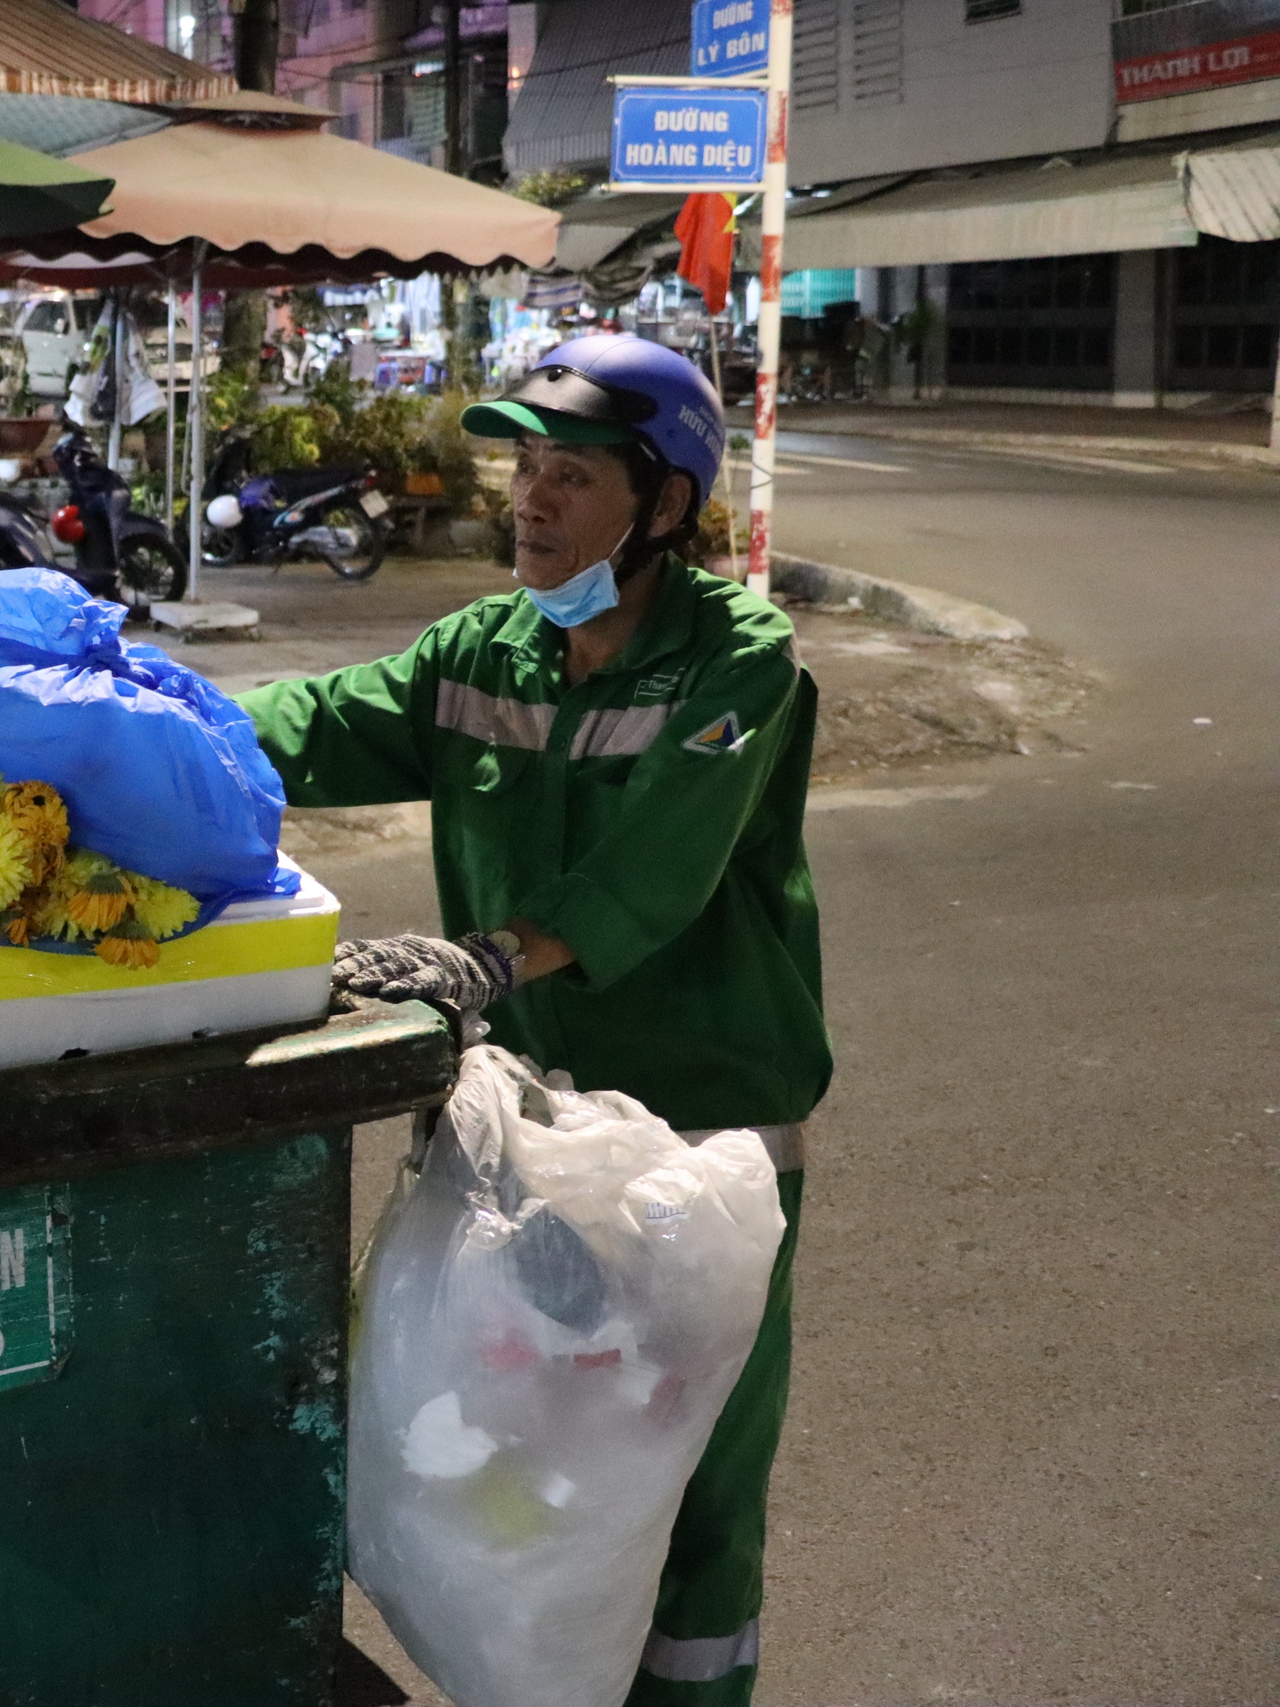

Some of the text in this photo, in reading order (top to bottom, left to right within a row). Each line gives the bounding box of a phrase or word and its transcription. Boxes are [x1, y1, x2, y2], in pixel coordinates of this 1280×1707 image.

[698, 31, 766, 66] LÝ BÔN
[654, 107, 729, 132] ĐƯỜNG
[625, 138, 752, 172] HOÀNG DIỆU
